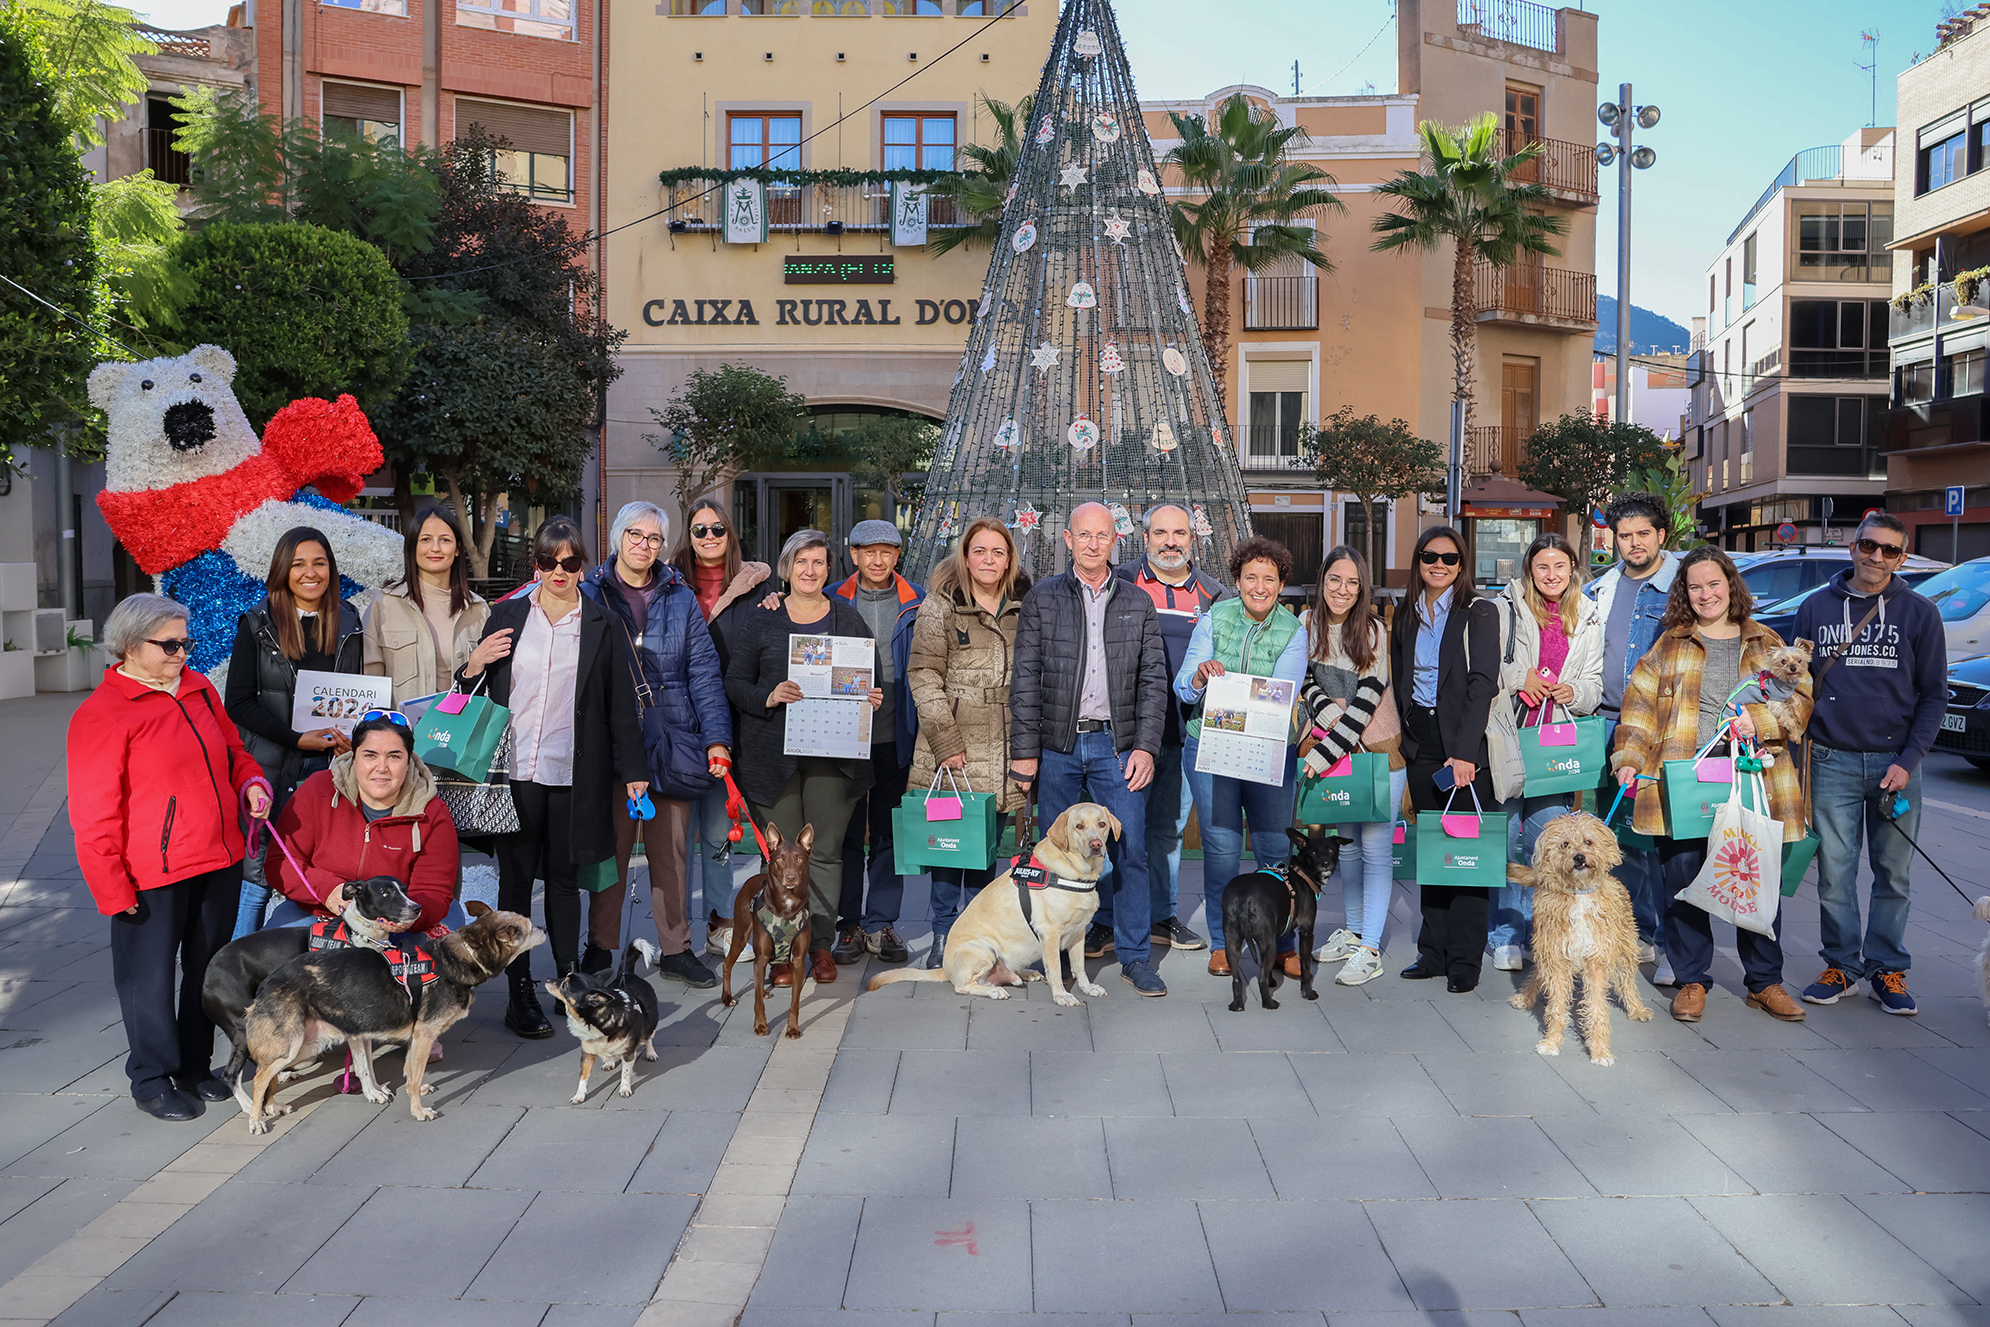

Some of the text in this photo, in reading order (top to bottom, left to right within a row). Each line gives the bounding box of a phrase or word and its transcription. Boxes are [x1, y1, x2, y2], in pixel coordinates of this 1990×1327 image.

[643, 299, 760, 326] CAIXA
[776, 299, 900, 326] RURAL
[1948, 490, 1959, 512] P
[313, 686, 377, 699] CALENDARI
[1948, 716, 1963, 730] GVZ
[428, 727, 451, 742] Onda
[1546, 758, 1580, 772] Onda
[1321, 790, 1350, 801] Onda
[1706, 884, 1758, 914] MOUSE
[410, 962, 426, 975] TEAM
